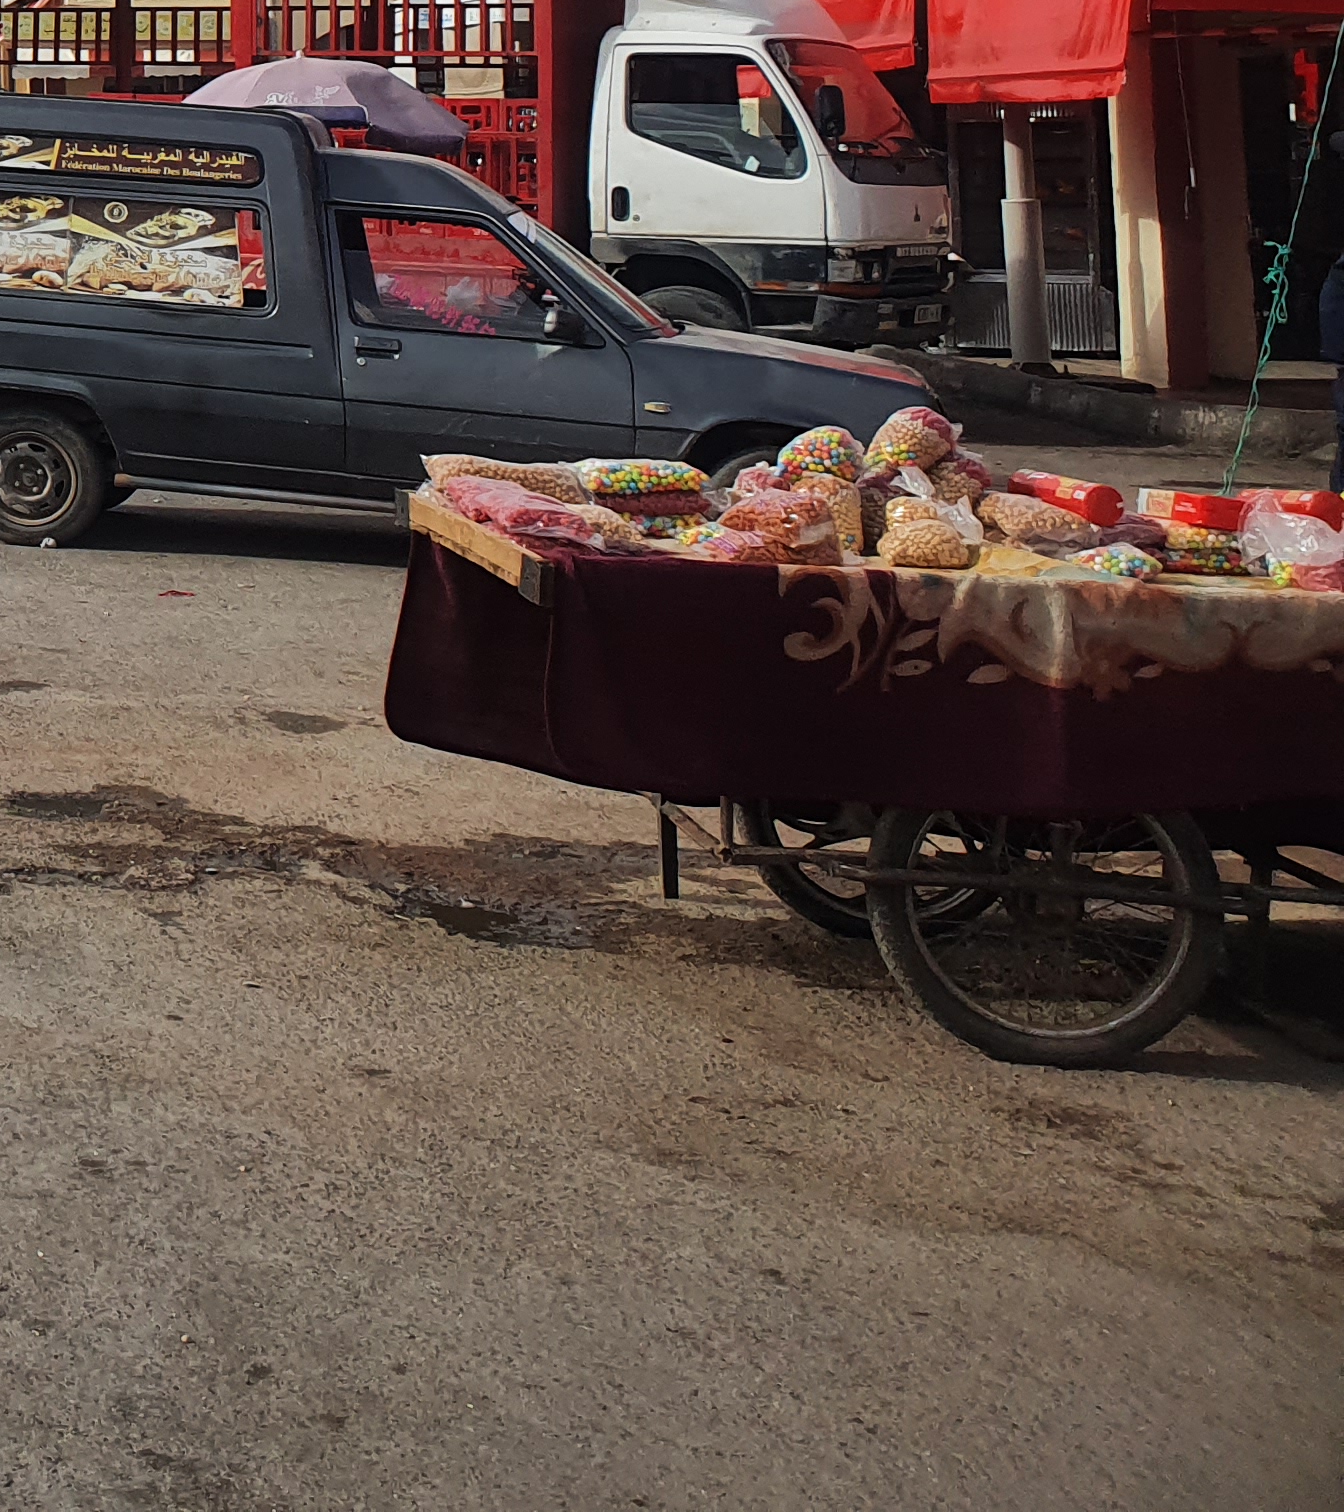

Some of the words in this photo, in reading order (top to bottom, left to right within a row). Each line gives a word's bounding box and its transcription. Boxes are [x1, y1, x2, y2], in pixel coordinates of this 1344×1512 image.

[121, 143, 183, 164] المغربية
[188, 147, 246, 169] الفيدرالية
[163, 166, 180, 177] Des
